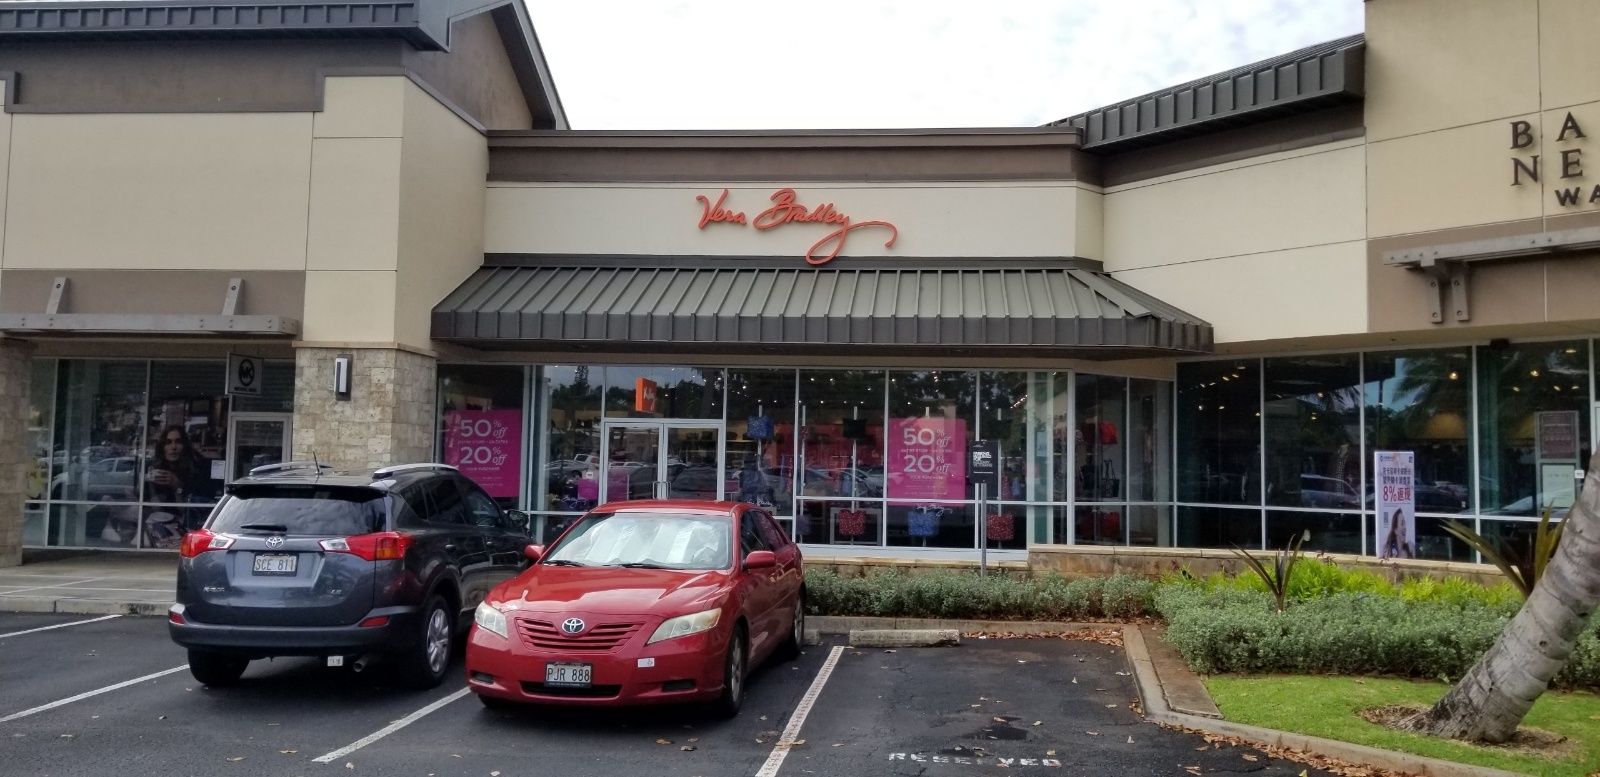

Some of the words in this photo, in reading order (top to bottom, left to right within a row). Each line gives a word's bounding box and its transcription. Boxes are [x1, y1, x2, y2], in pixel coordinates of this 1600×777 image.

[695, 187, 748, 231] Vera
[752, 187, 899, 265] Bradley
[255, 558, 272, 571] SCE
[277, 558, 295, 572] 811
[547, 667, 566, 681] PJR
[571, 668, 590, 682] 888
